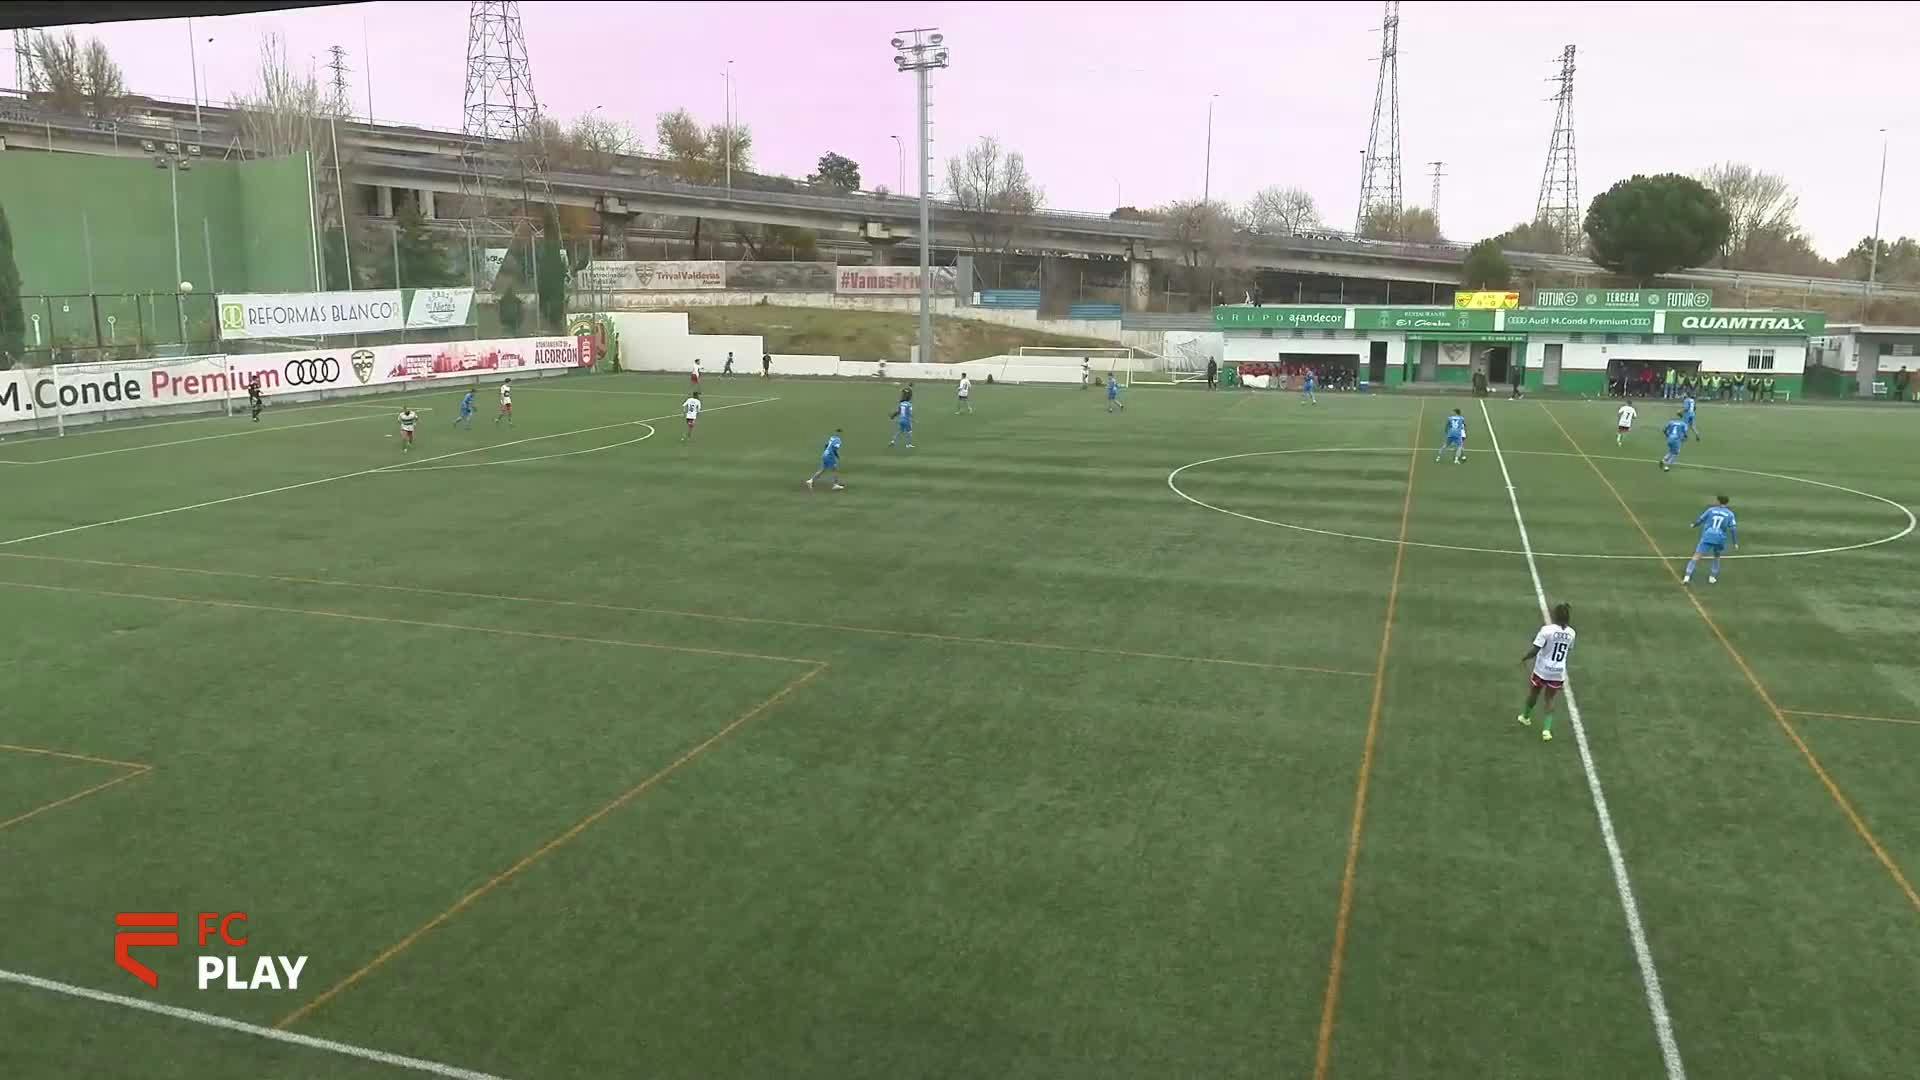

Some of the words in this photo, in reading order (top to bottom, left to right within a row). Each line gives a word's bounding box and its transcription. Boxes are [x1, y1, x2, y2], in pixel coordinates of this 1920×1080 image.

[1606, 292, 1639, 302] TERCERA
[249, 305, 327, 325] REFORMAS
[1289, 312, 1342, 327] afandecor
[1528, 317, 1549, 325] Audi
[1551, 317, 1587, 325] M.Conde
[1590, 317, 1629, 325] Premium
[1682, 317, 1806, 330] QUAMTRAX
[151, 365, 280, 398] Premium
[1712, 515, 1725, 529] 17
[1551, 642, 1568, 662] 15
